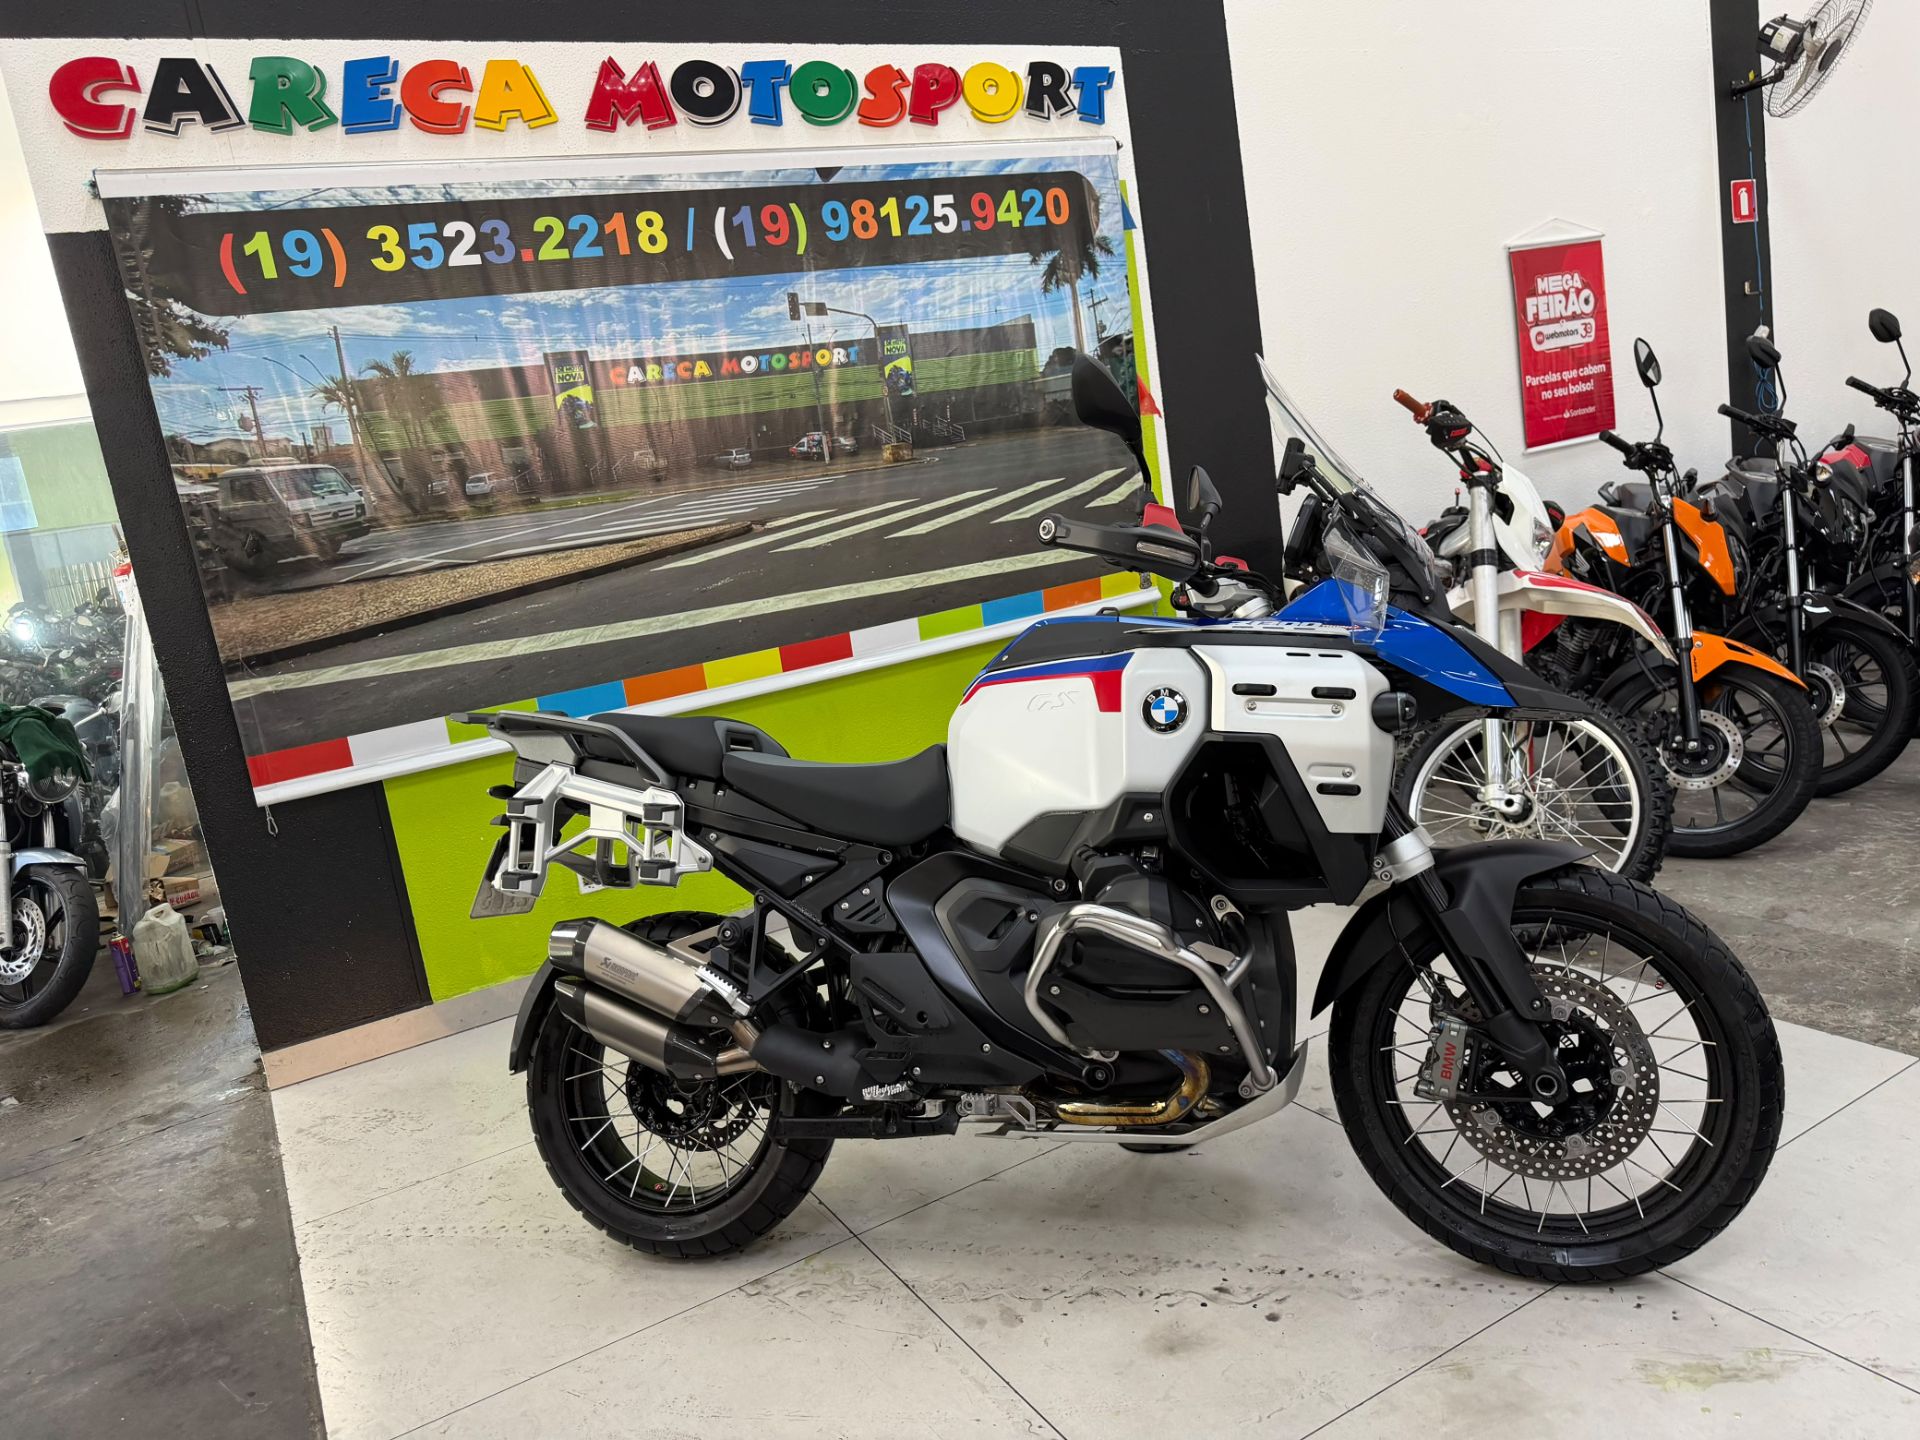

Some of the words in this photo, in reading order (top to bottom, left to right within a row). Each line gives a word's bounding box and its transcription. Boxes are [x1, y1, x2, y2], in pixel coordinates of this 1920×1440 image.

[49, 55, 558, 140] CARECA
[585, 55, 1114, 133] MOTOSPORT
[220, 228, 347, 294] (19)
[366, 211, 667, 273] 3523.2218
[685, 207, 695, 252] /
[715, 201, 809, 261] (19)
[824, 187, 1069, 242] 98125.9420
[1536, 272, 1582, 294] MEGA
[1525, 287, 1595, 322] FEIRÃO
[1545, 328, 1579, 341] webmotors
[609, 360, 712, 385] CARECA
[721, 345, 860, 376] MOTOSPORT
[1525, 371, 1561, 387] Parcelas
[1562, 369, 1578, 382] que
[1579, 363, 1606, 376] cabem
[1541, 390, 1552, 400] no
[1554, 387, 1568, 398] seu
[1569, 379, 1594, 394] bolso!
[1440, 1042, 1457, 1080] BMW
